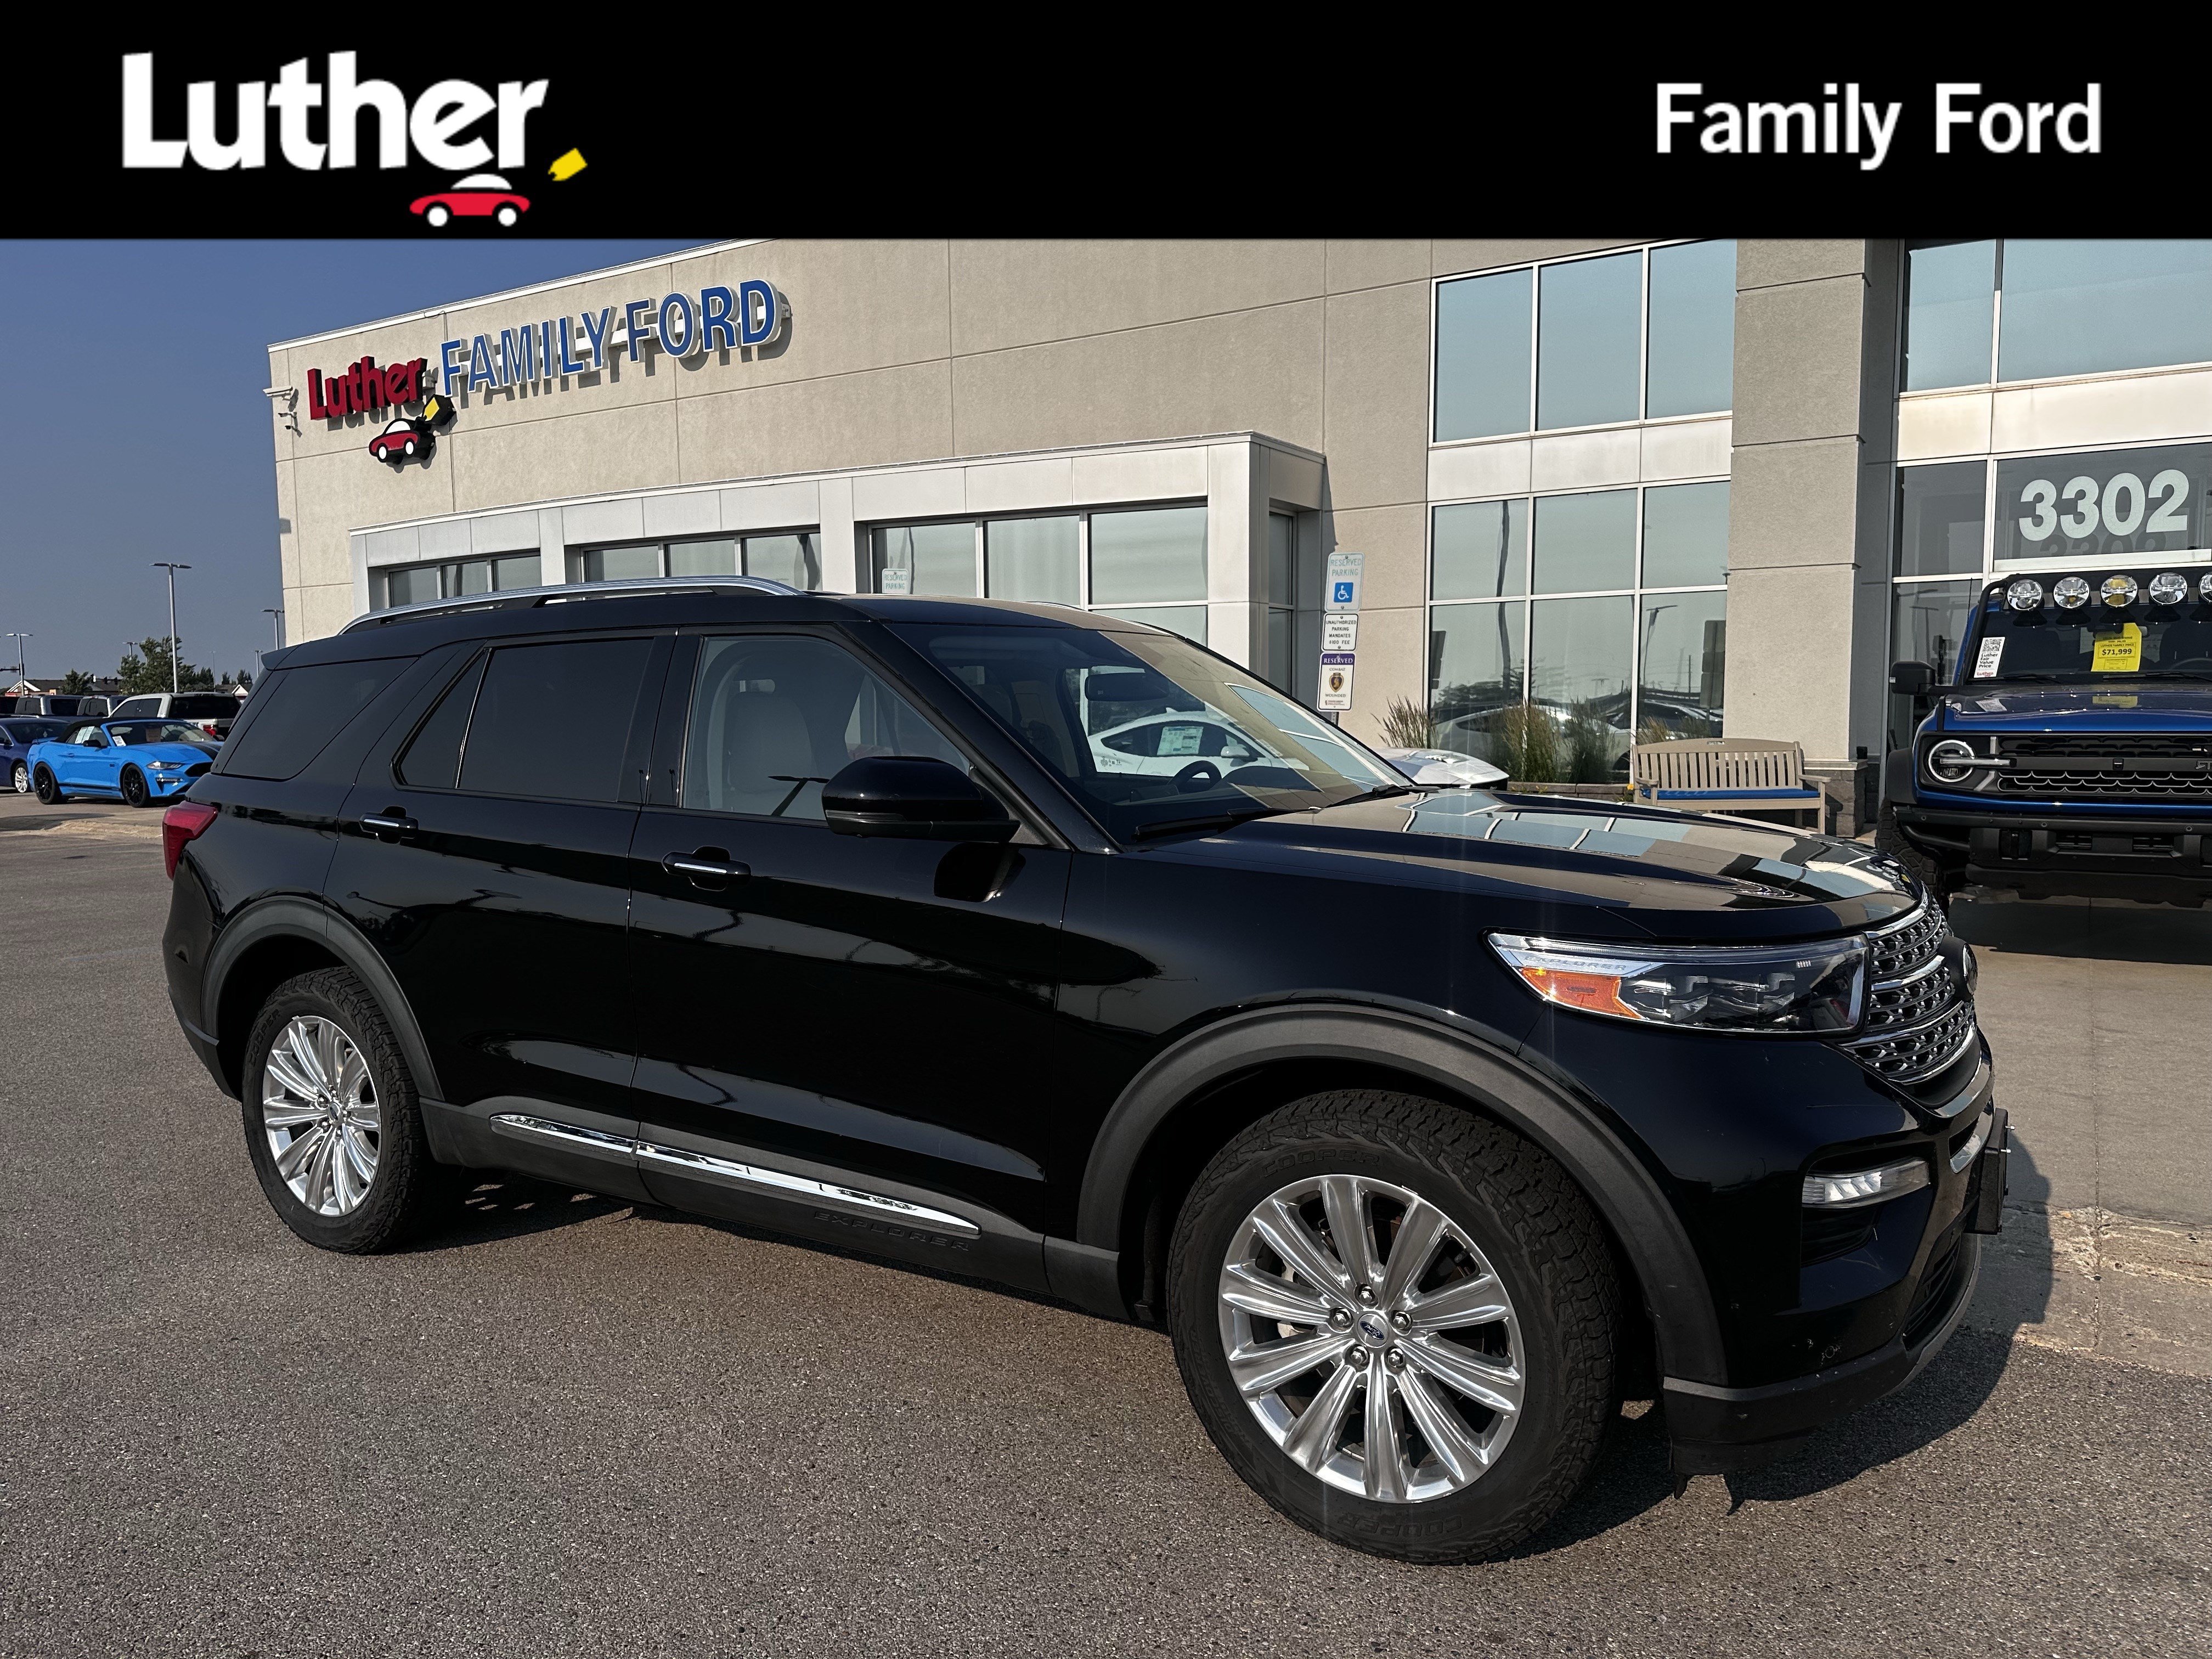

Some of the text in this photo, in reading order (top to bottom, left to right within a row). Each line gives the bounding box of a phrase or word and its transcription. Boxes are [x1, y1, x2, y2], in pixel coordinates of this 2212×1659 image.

[441, 279, 781, 397] FAMILY FORD
[307, 356, 427, 420] Luther
[2019, 469, 2189, 541] 3302
[1330, 558, 1362, 567] RESERVED
[1331, 568, 1358, 577] PARKING
[2102, 648, 2132, 656] $71,999
[1525, 955, 1627, 970] EXPLORER
[1263, 1148, 1380, 1178] COOPER
[814, 1211, 969, 1251] EXPLORER
